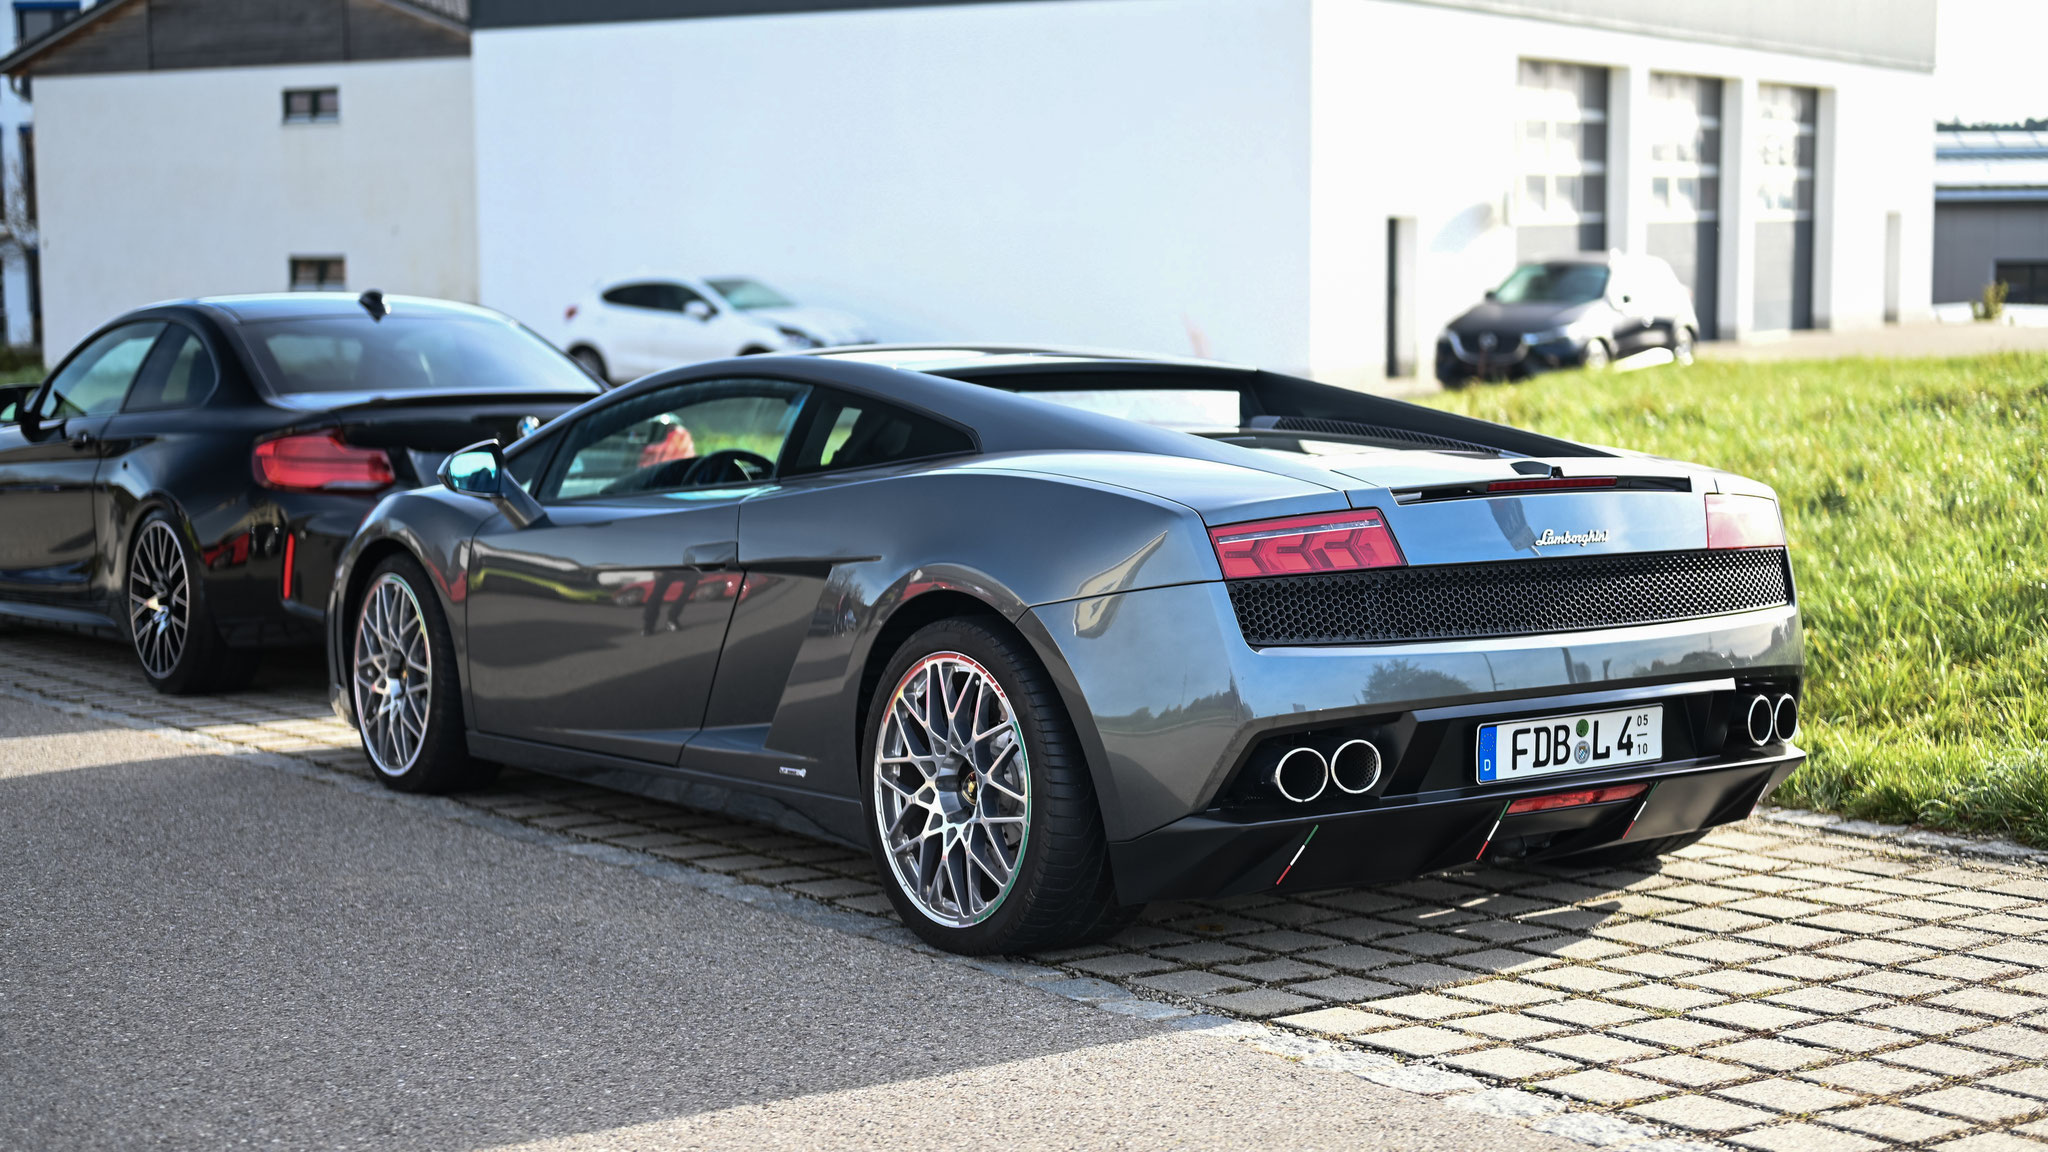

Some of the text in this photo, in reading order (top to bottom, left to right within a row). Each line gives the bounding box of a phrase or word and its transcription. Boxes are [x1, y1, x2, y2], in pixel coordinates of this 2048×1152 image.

[1535, 529, 1609, 547] Lamborghini
[1637, 714, 1649, 727] 05
[1511, 716, 1634, 771] FDB L 4
[1637, 742, 1648, 756] 10
[1483, 759, 1491, 772] D
